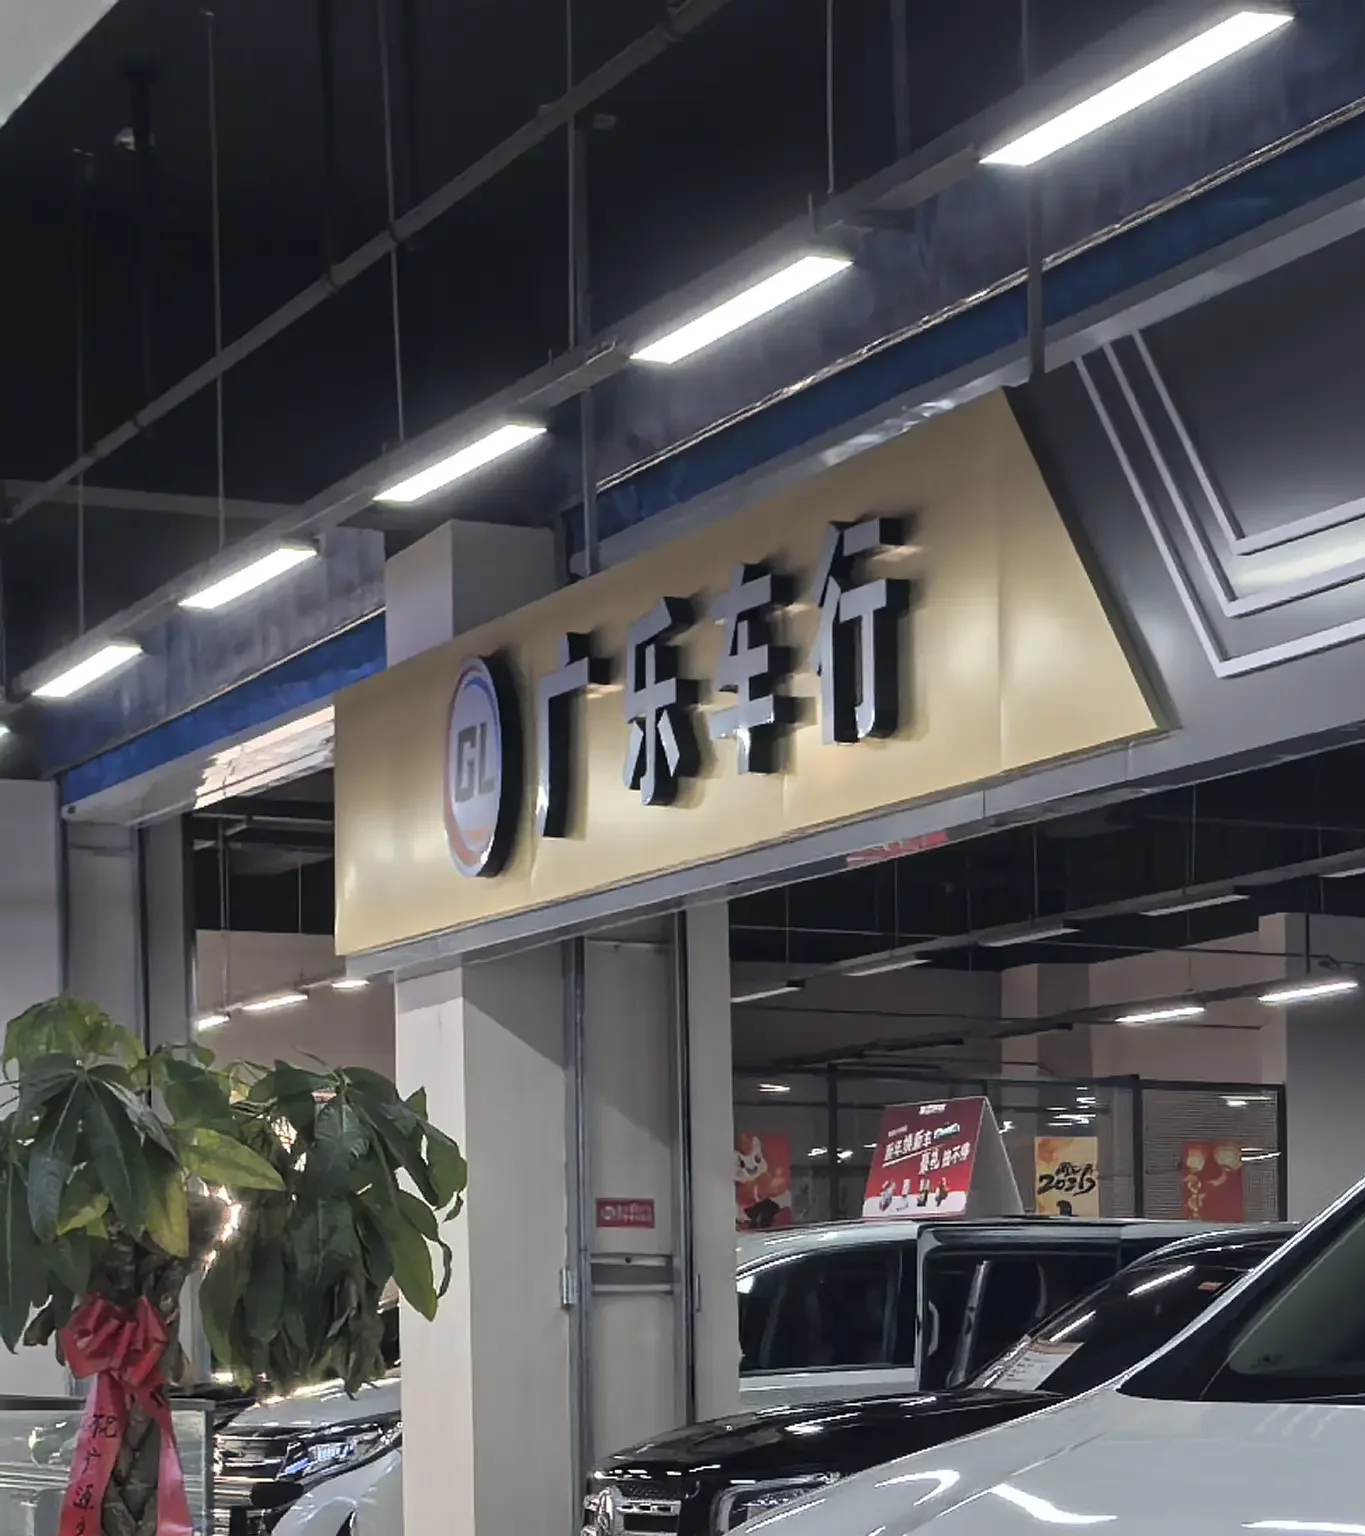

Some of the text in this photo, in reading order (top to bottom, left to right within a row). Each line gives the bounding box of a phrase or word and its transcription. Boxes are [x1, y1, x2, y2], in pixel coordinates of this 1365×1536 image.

[455, 516, 908, 838] GL 广乐车行
